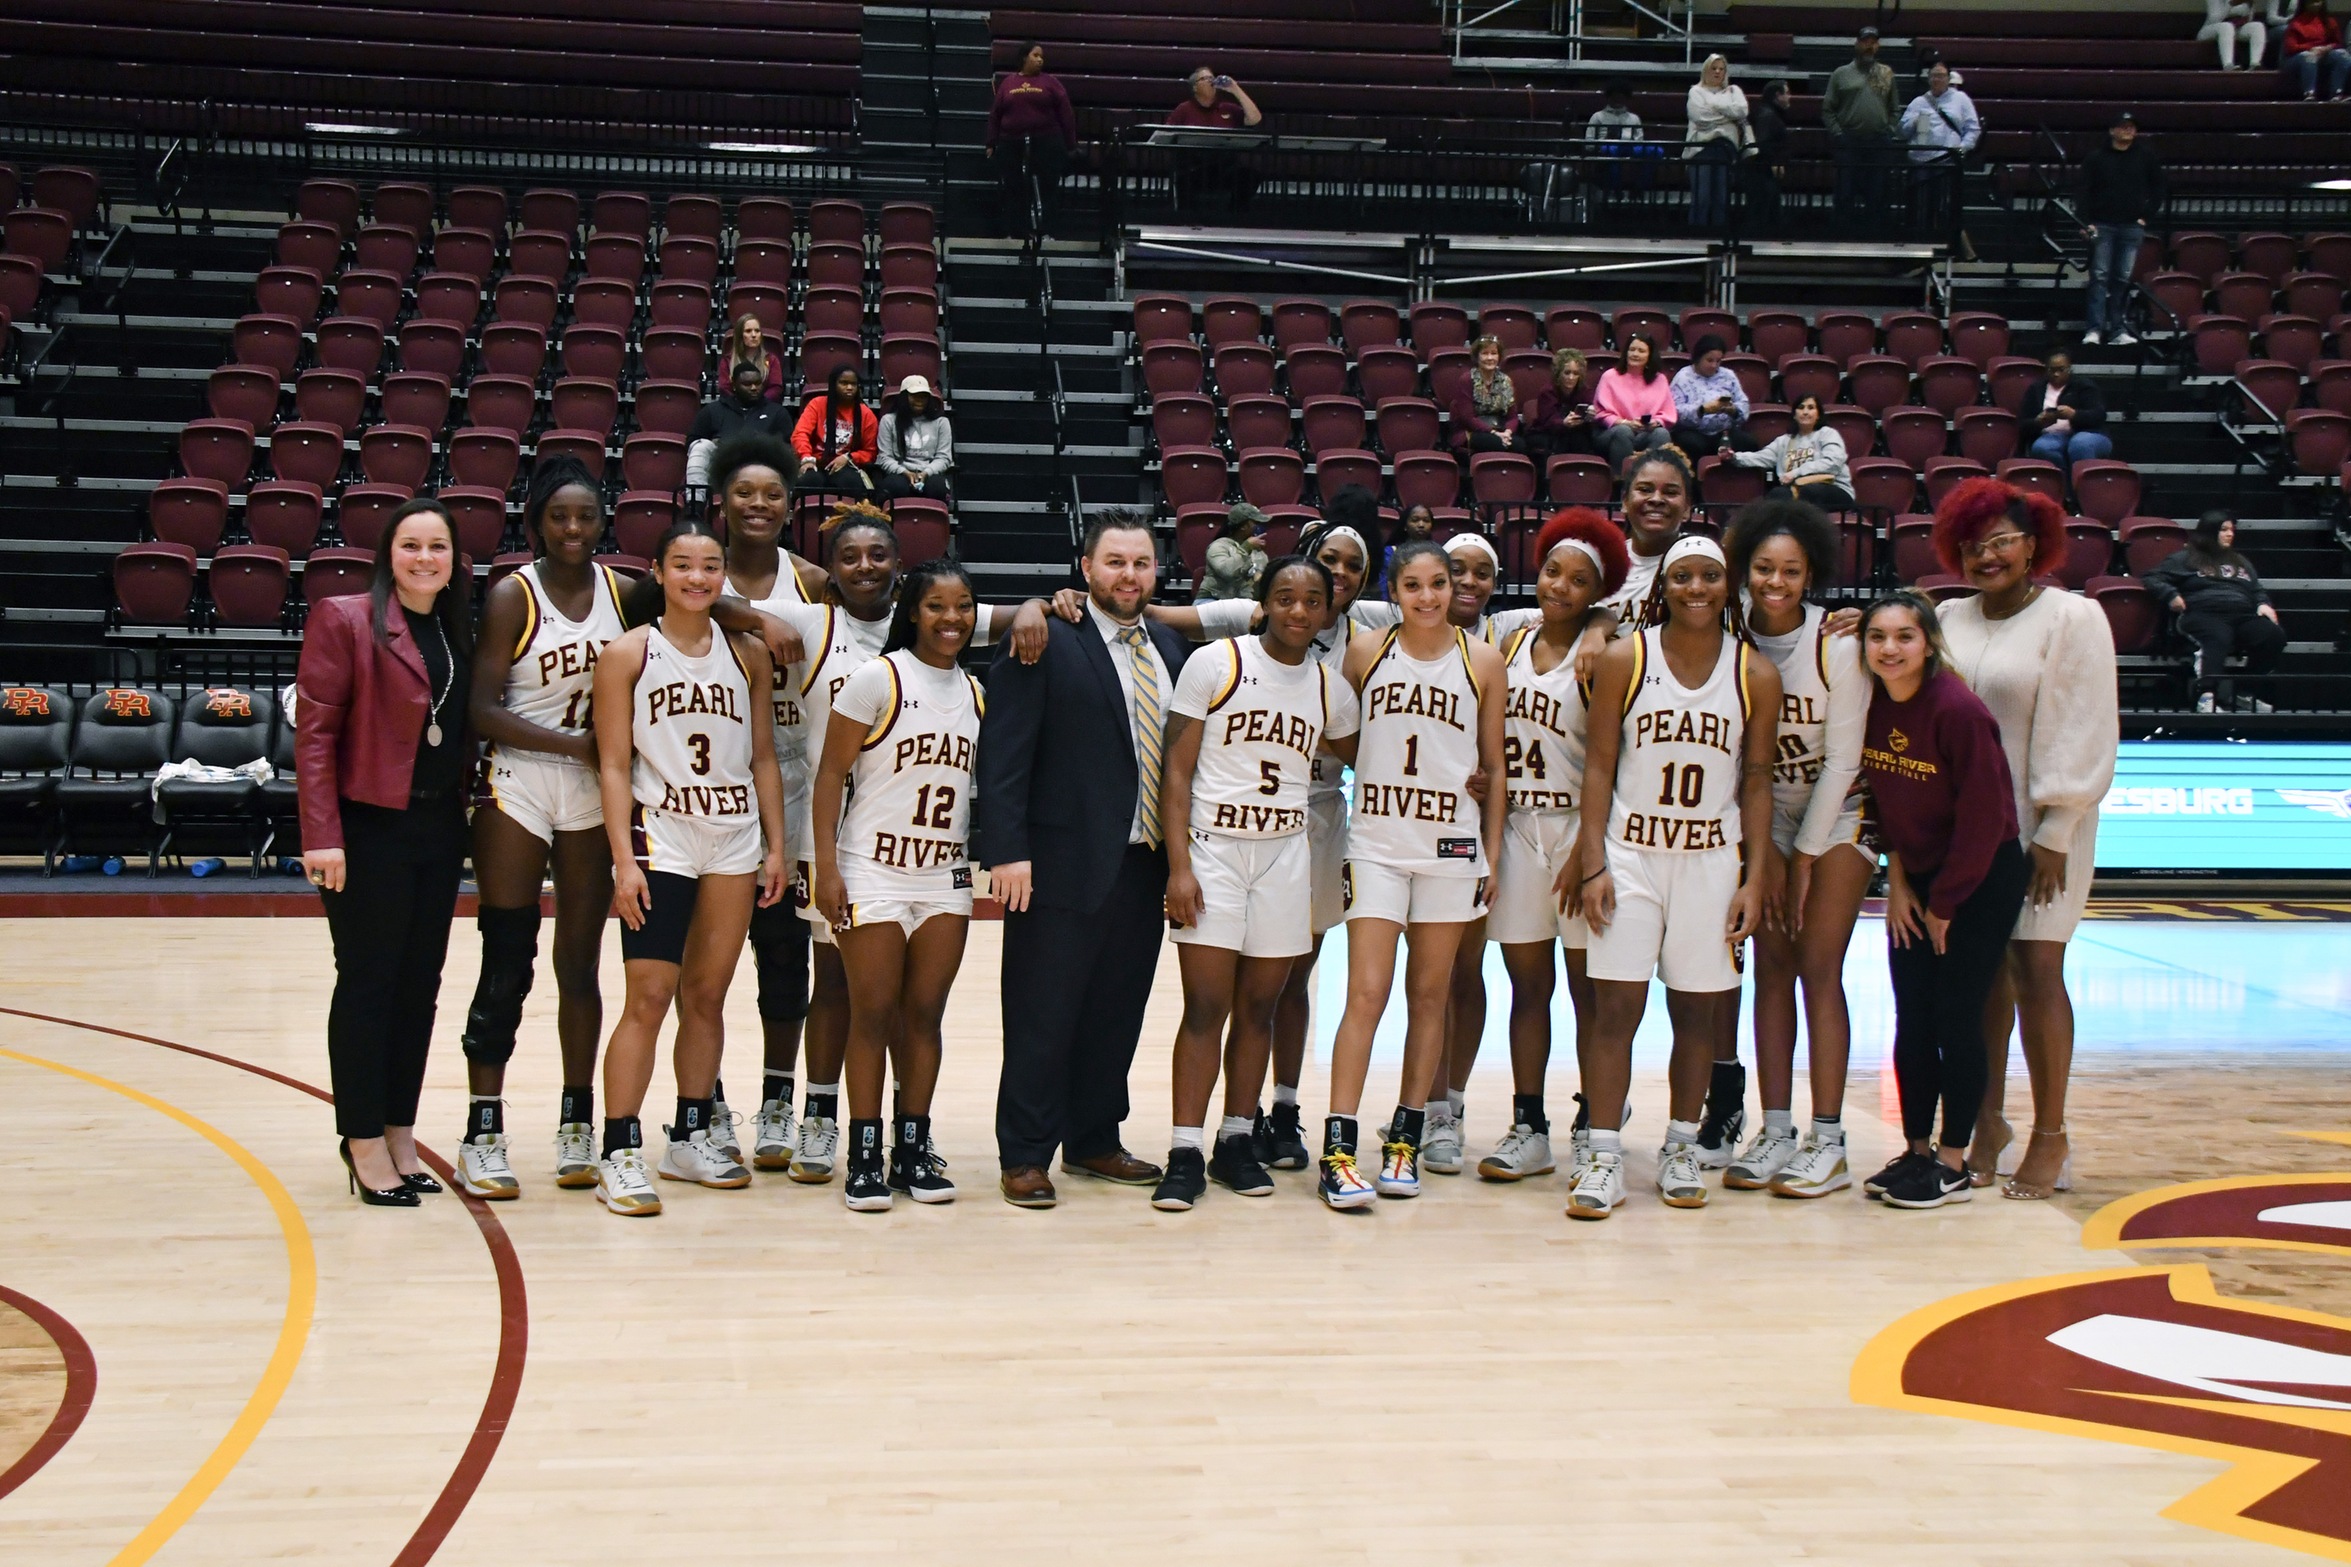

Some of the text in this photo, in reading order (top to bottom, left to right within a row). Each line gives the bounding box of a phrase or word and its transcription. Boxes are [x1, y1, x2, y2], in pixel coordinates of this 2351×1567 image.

[538, 639, 611, 687] PEA
[648, 682, 743, 726] PEARL
[1369, 683, 1465, 732] PEARL
[1505, 686, 1566, 738] EARL
[687, 733, 711, 776] 3
[1223, 710, 1315, 762] PEARL
[1636, 709, 1731, 756] PEARL
[1404, 734, 1418, 777] 1
[1505, 736, 1546, 780] 24
[660, 782, 749, 816] RIVER
[1258, 760, 1281, 796] 5
[1658, 762, 1705, 808] 10
[911, 783, 956, 830] 12
[1213, 803, 1305, 832] RIVER
[1361, 783, 1458, 823] RIVER
[1623, 812, 1727, 850] RIVER
